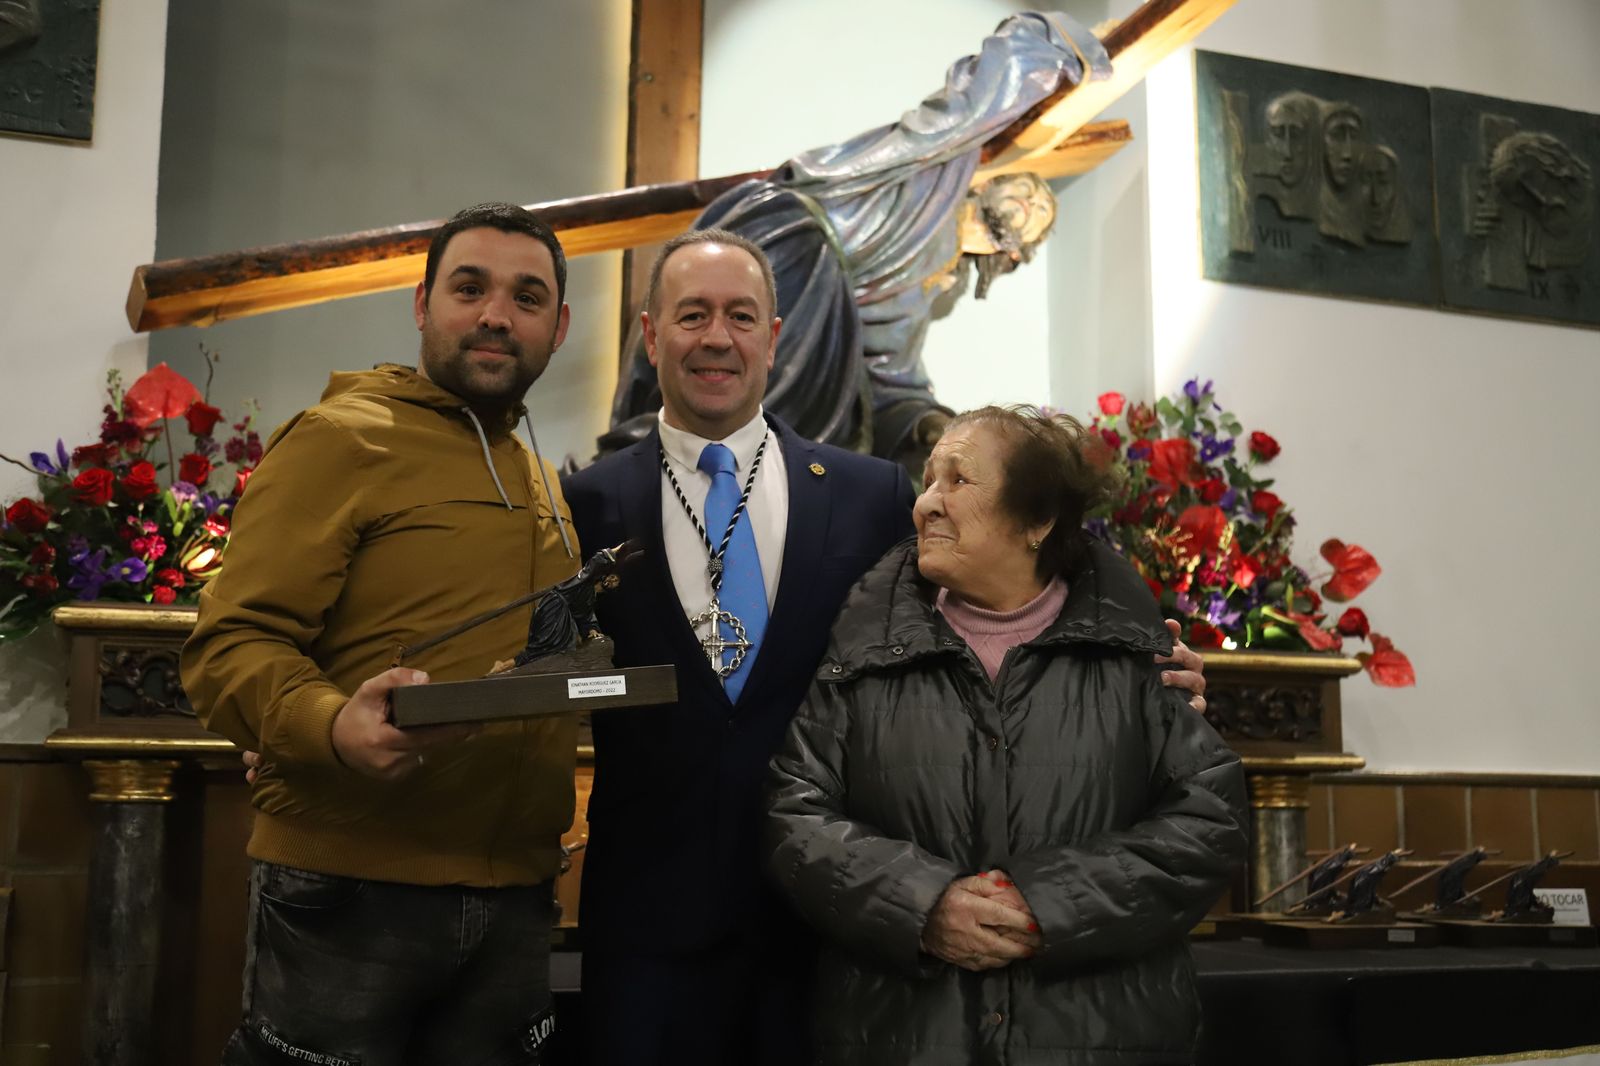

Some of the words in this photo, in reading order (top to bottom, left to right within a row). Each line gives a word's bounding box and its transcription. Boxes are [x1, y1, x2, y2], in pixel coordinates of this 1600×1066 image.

[1258, 225, 1291, 249] VIII
[1530, 280, 1550, 300] IX
[1551, 894, 1584, 905] TOCAR
[261, 1026, 270, 1040] MY
[267, 1034, 288, 1053] LIFE'S
[288, 1046, 325, 1064] GETTING
